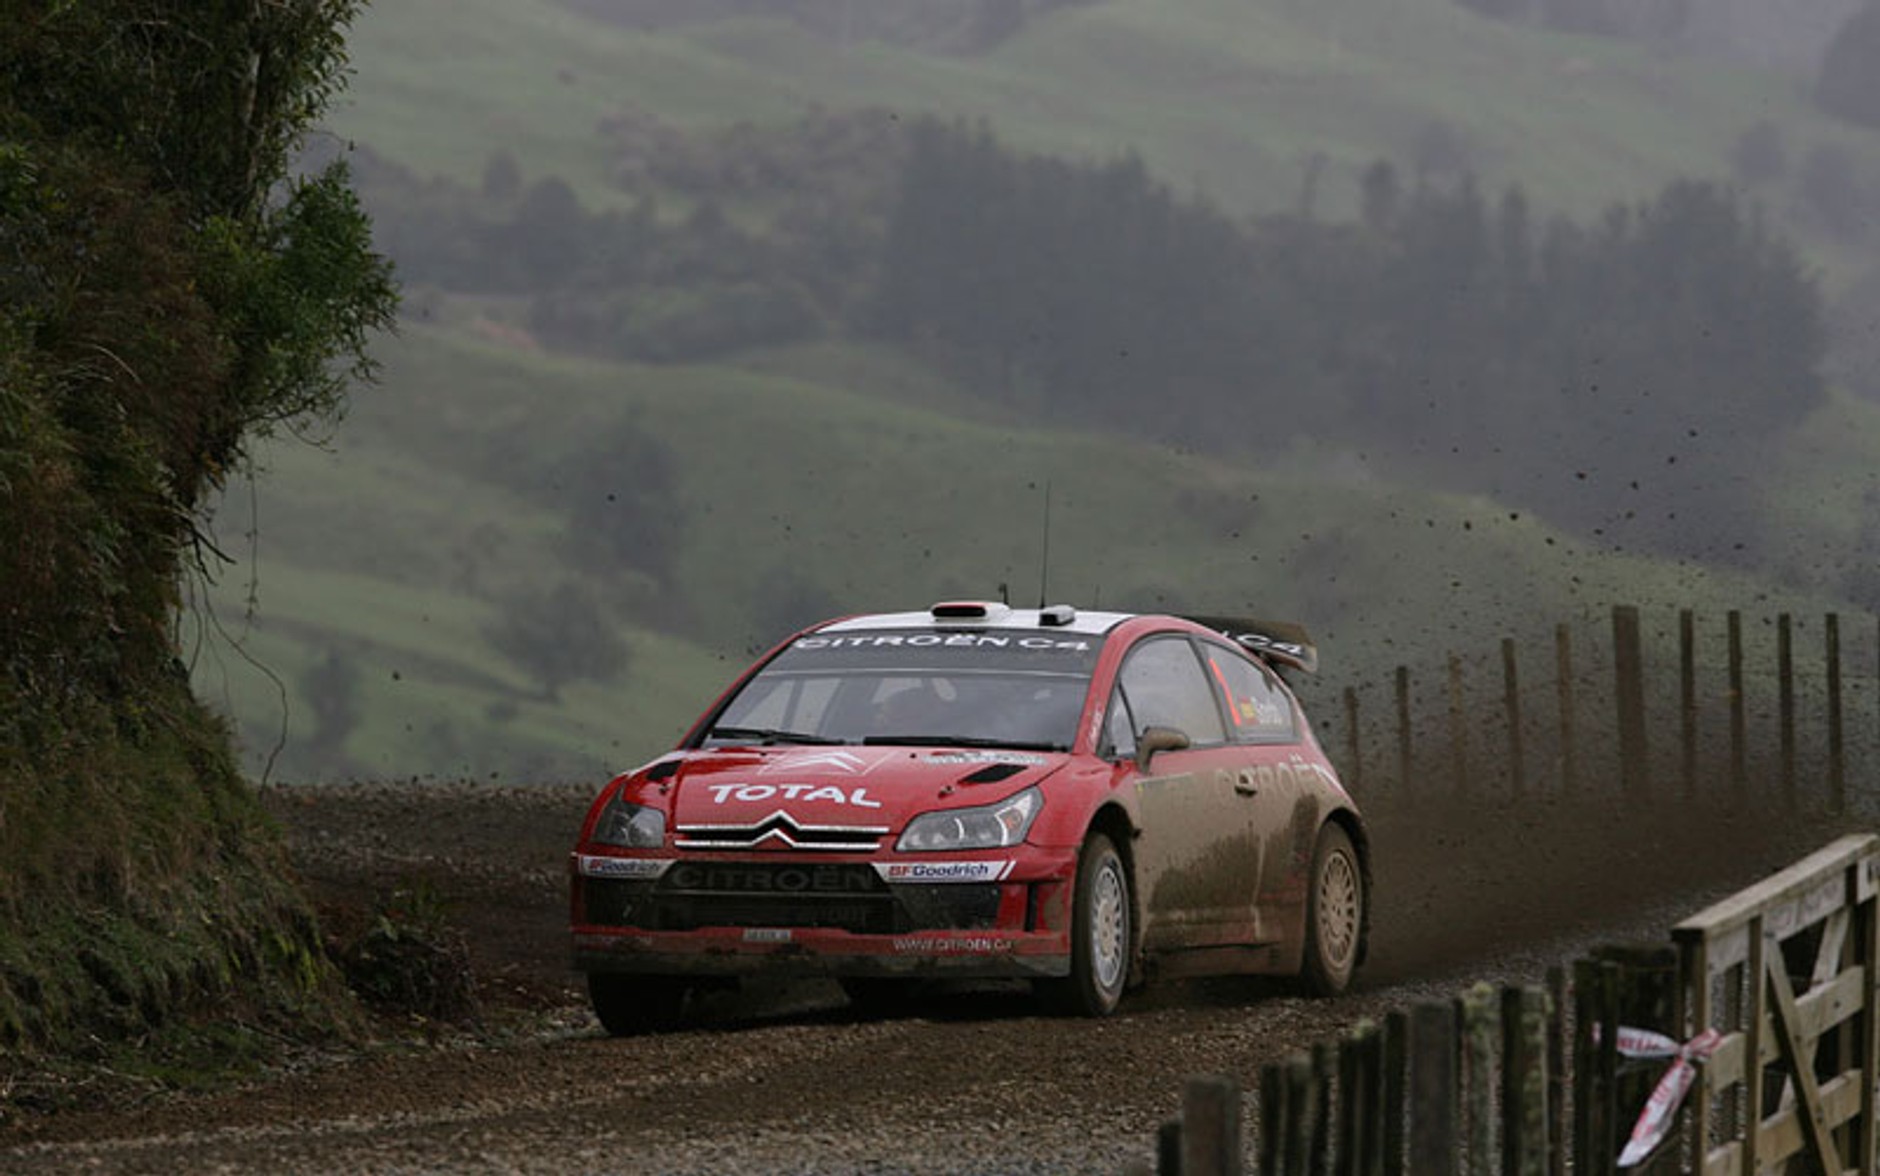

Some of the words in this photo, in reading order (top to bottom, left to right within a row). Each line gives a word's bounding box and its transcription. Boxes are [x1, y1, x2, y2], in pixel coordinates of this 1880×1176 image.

[796, 633, 1010, 649] CITROËN
[1019, 637, 1089, 650] C4
[1237, 634, 1302, 654] C4
[708, 783, 881, 808] TOTAL
